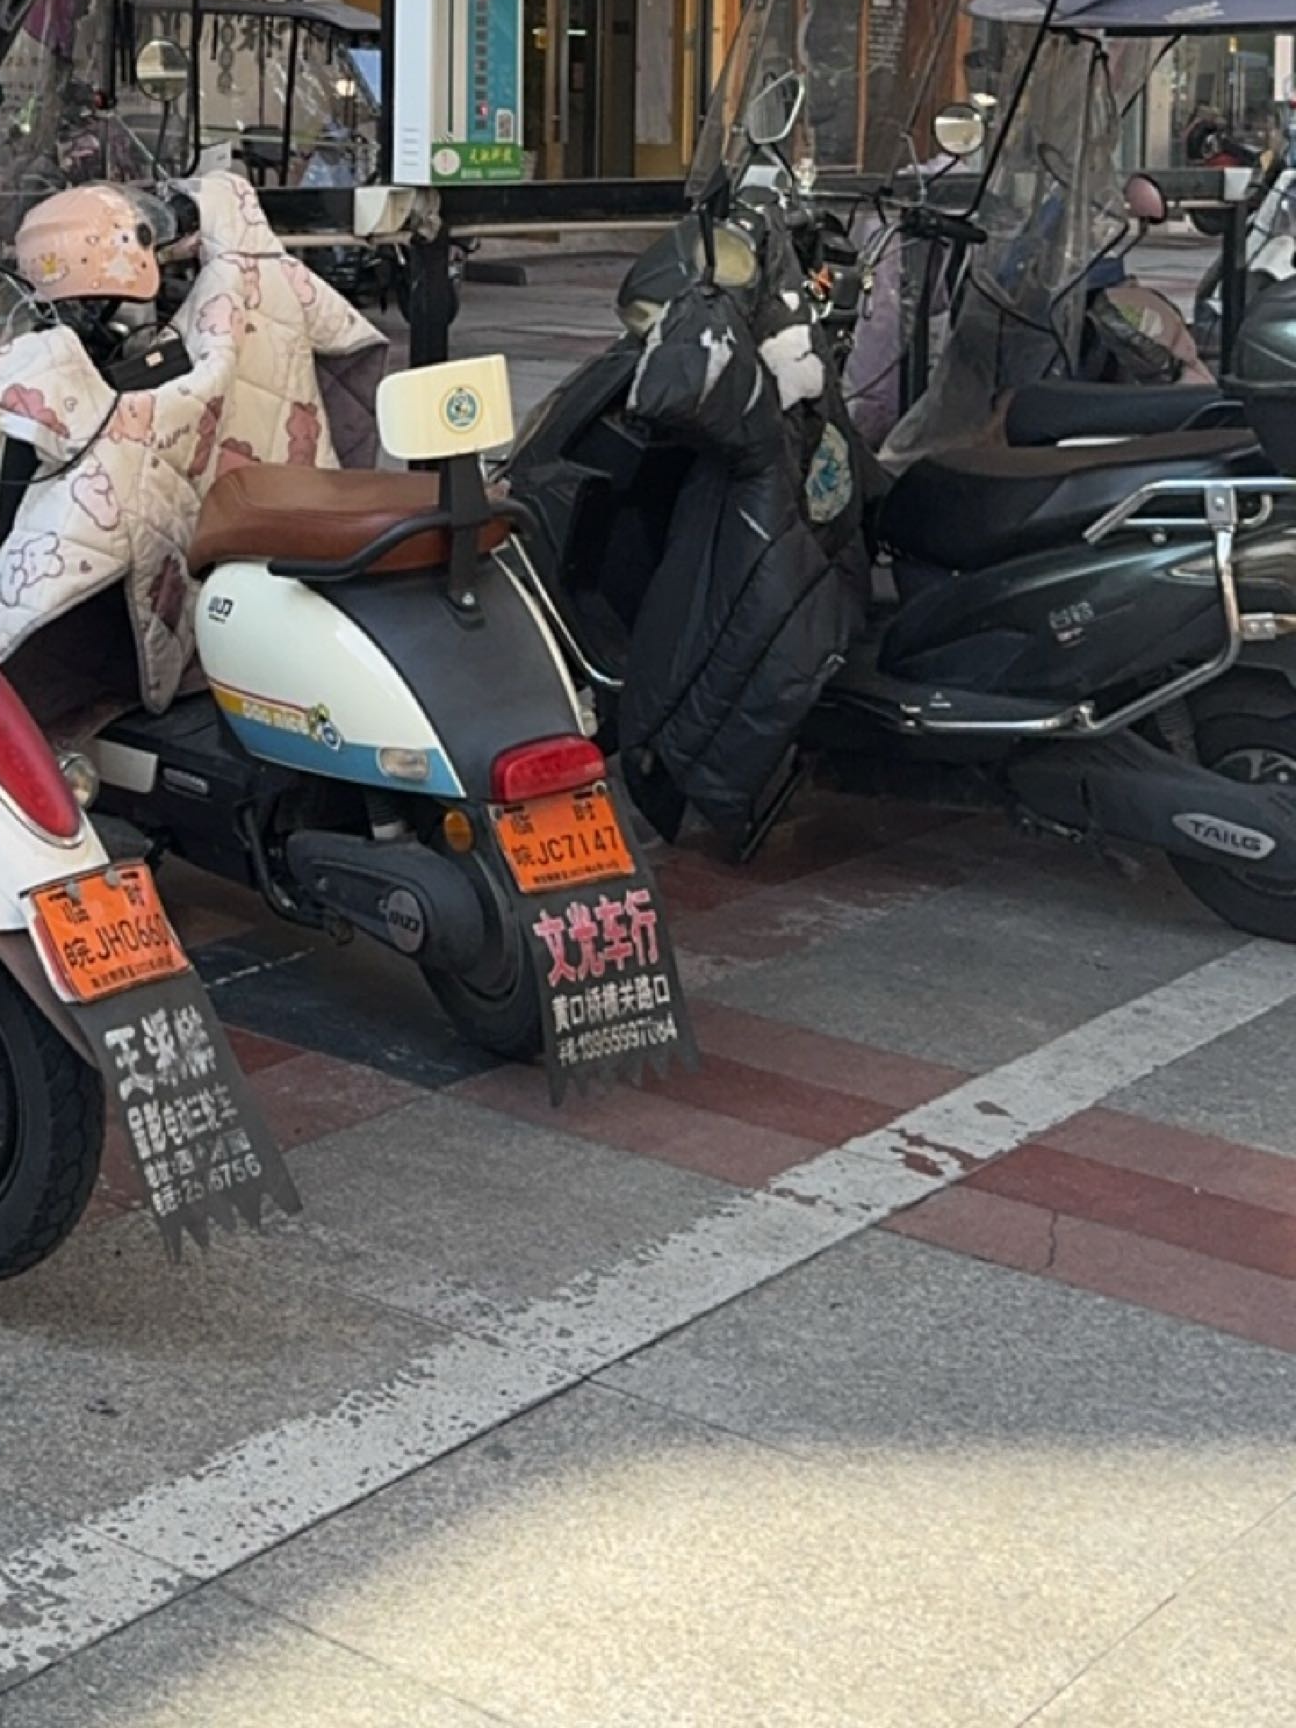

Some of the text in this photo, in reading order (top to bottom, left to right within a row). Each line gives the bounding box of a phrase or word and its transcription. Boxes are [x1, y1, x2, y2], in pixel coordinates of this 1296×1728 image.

[1188, 817, 1262, 852] TAILG
[532, 888, 660, 987] 文光车行
